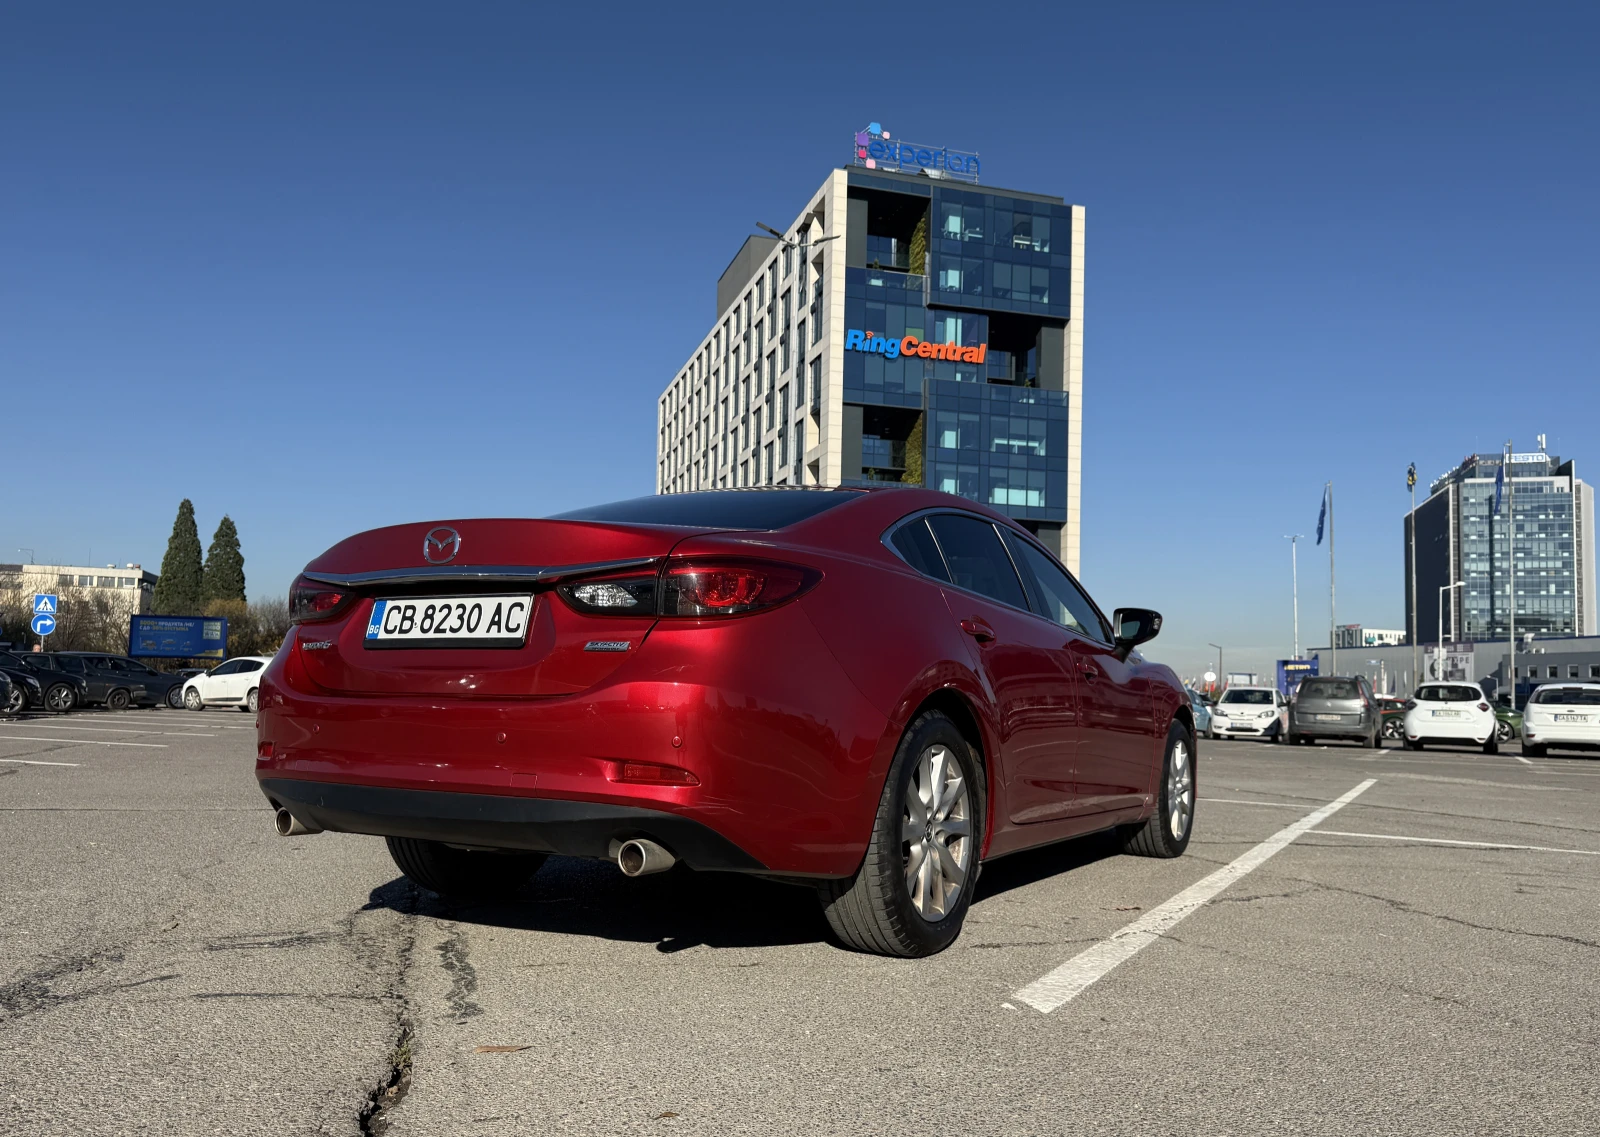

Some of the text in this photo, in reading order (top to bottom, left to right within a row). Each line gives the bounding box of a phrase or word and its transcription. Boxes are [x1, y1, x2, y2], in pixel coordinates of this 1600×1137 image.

[868, 141, 980, 175] experian
[845, 328, 987, 364] RingCentral
[369, 624, 380, 634] BG
[383, 602, 525, 635] CB 8230 AC
